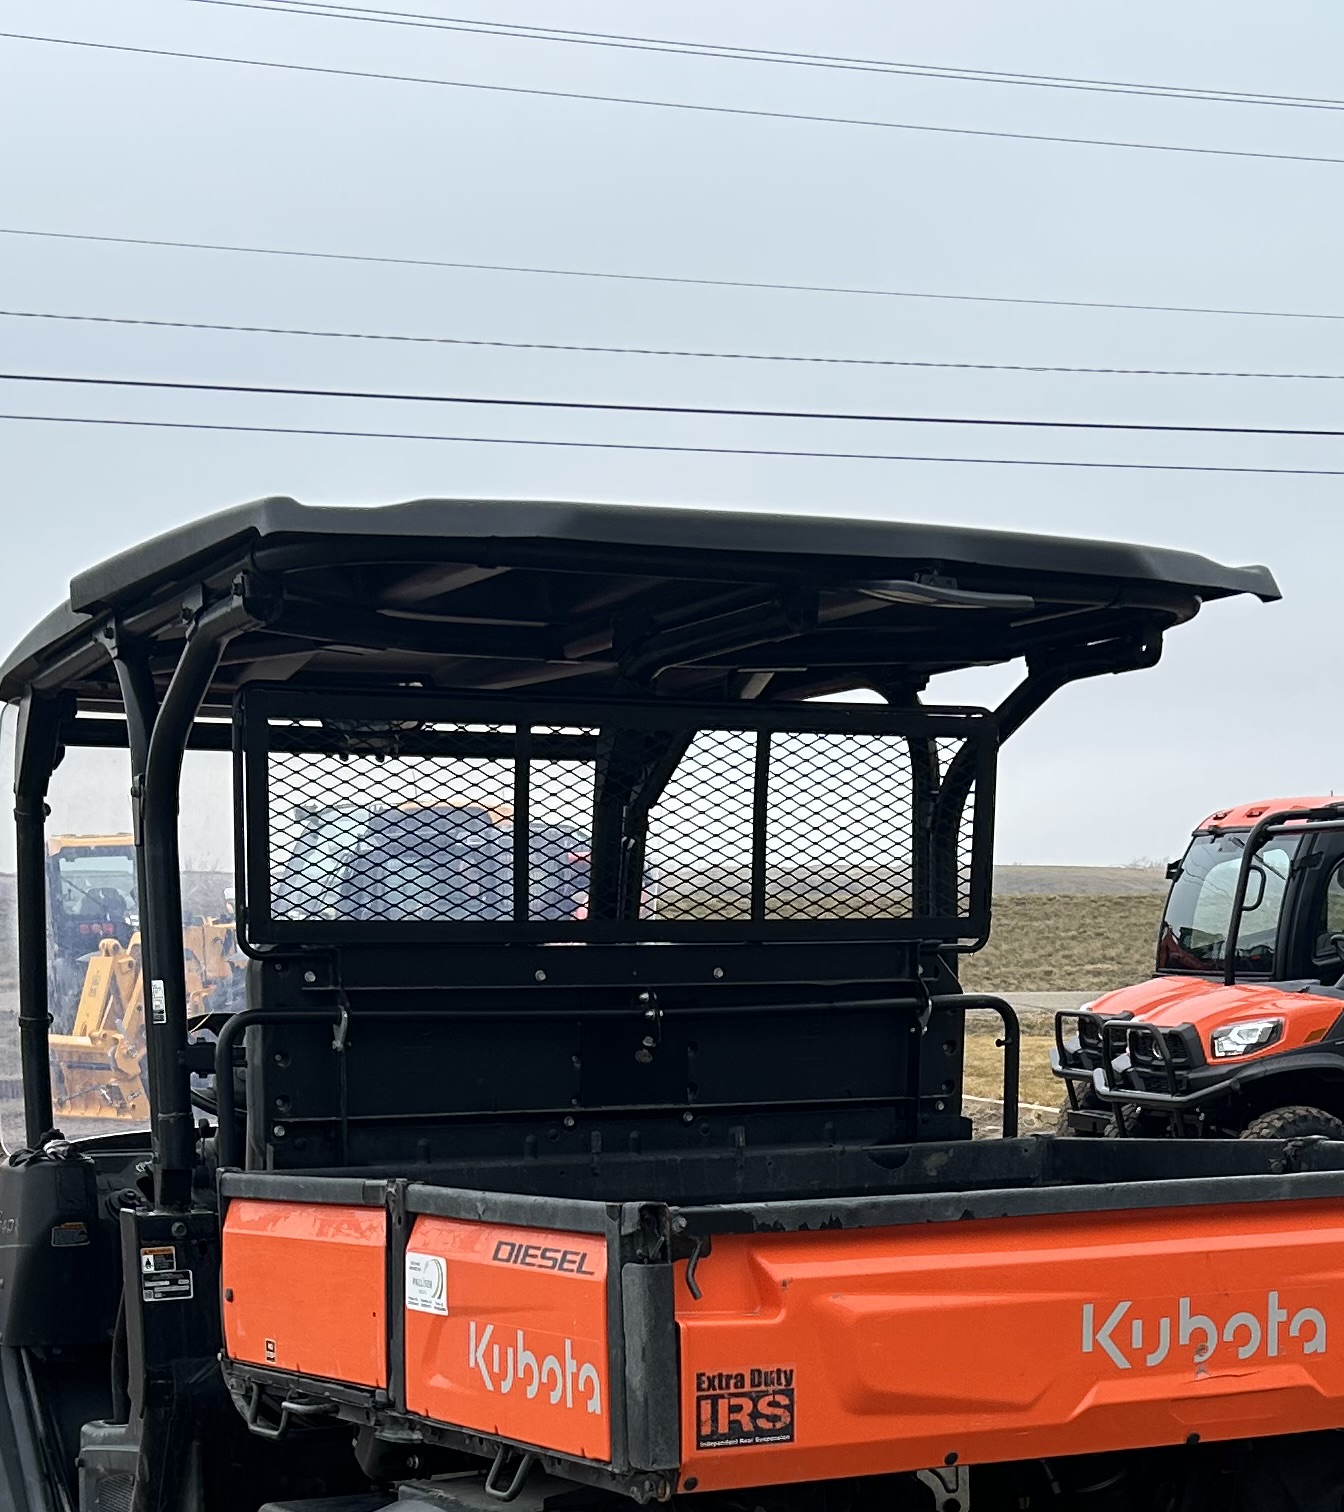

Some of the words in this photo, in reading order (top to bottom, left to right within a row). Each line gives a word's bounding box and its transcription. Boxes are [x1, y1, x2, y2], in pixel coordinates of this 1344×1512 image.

[492, 1240, 595, 1276] DIESEL
[1082, 1291, 1327, 1369] Kubota
[469, 1320, 601, 1415] Kubota
[696, 1371, 746, 1392] Extra
[750, 1367, 794, 1388] Duty
[700, 1394, 791, 1436] IRS
